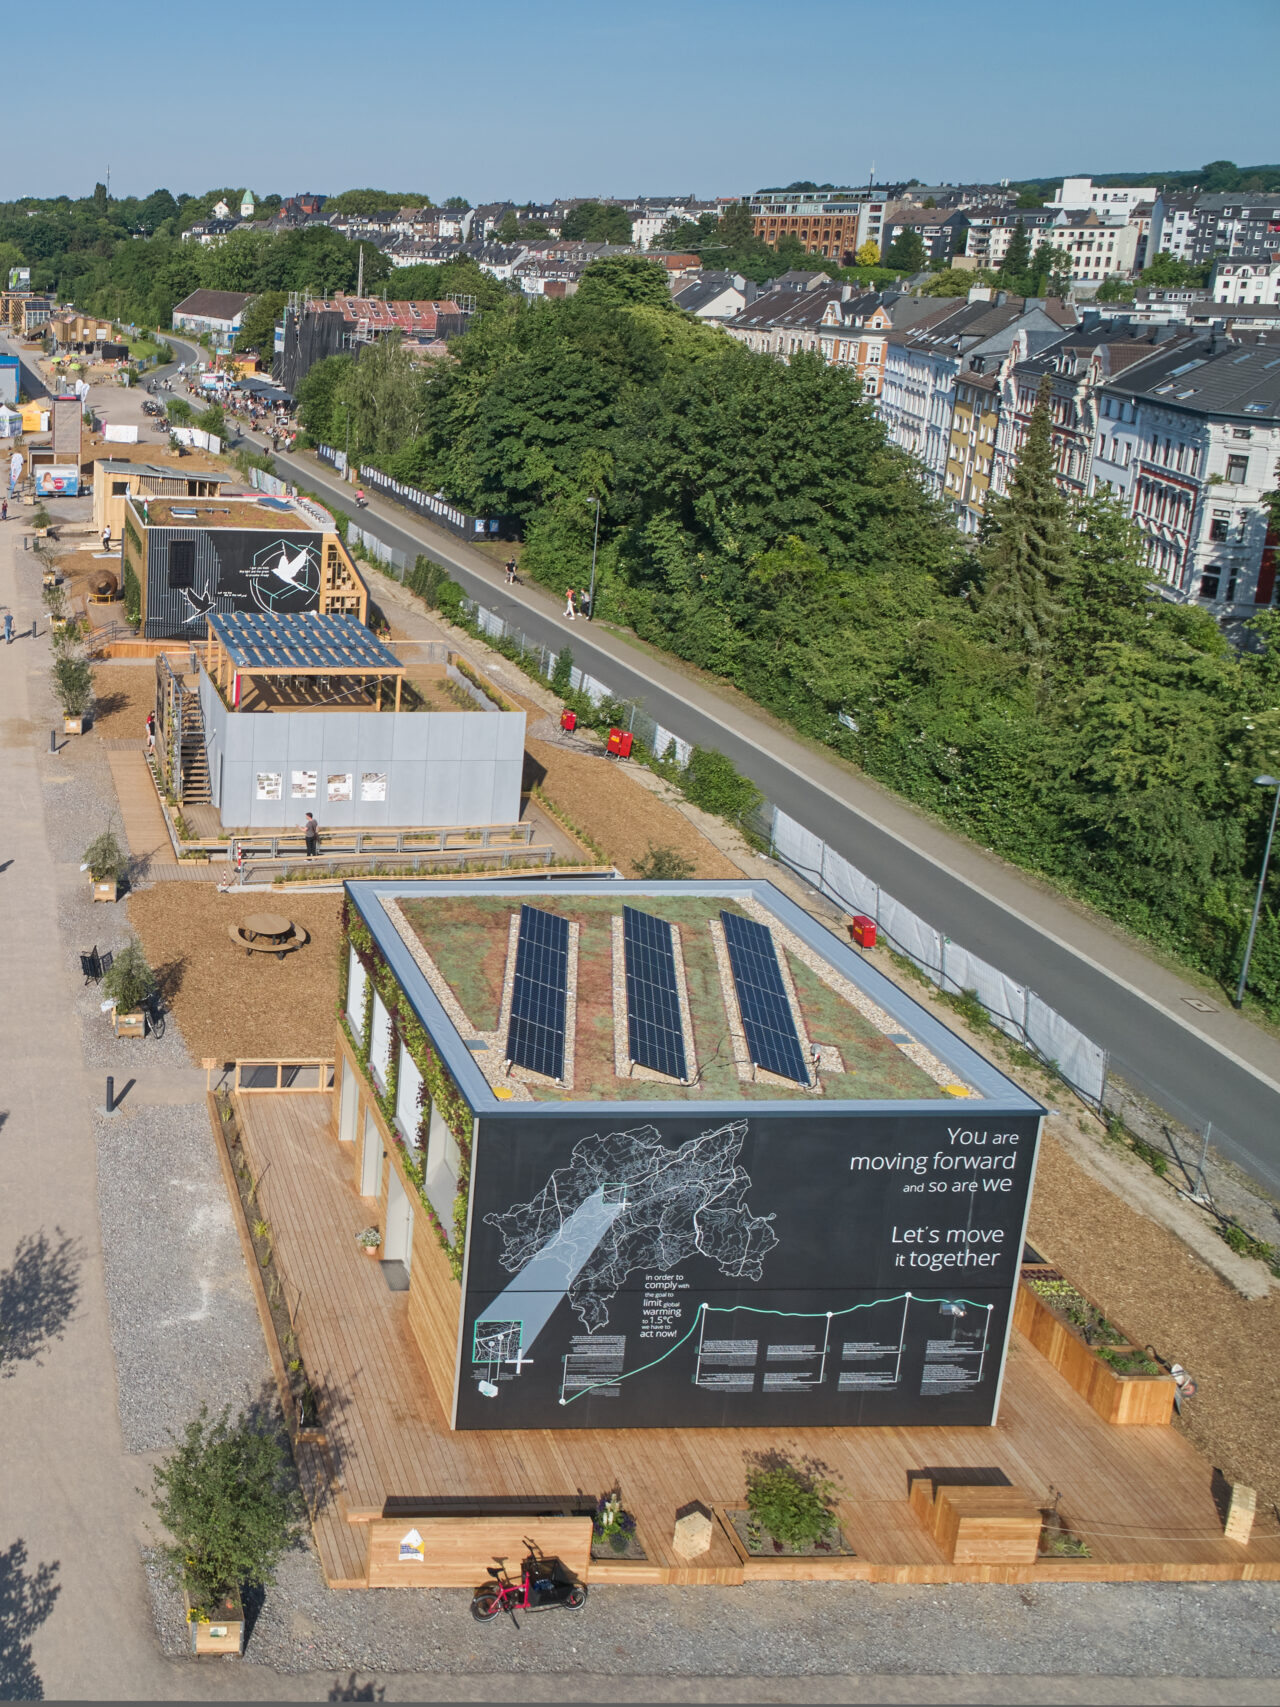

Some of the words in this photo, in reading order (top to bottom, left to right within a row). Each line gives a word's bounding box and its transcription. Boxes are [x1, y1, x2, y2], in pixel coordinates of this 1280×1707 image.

[947, 1127, 987, 1145] You
[992, 1133, 1020, 1145] are
[850, 1152, 929, 1175] moving
[933, 1151, 1017, 1170] forward
[903, 1183, 925, 1193] and
[928, 1181, 948, 1193] so
[951, 1181, 978, 1193] are
[982, 1178, 1013, 1192] we
[891, 1226, 941, 1243] Let's
[946, 1229, 1004, 1243] move
[895, 1254, 906, 1267] it
[909, 1249, 1002, 1272] together
[644, 1281, 678, 1290] comply
[643, 1299, 663, 1307] limit
[642, 1308, 682, 1317] warming
[649, 1316, 674, 1324] 1.5°C
[655, 1330, 677, 1338] now!
